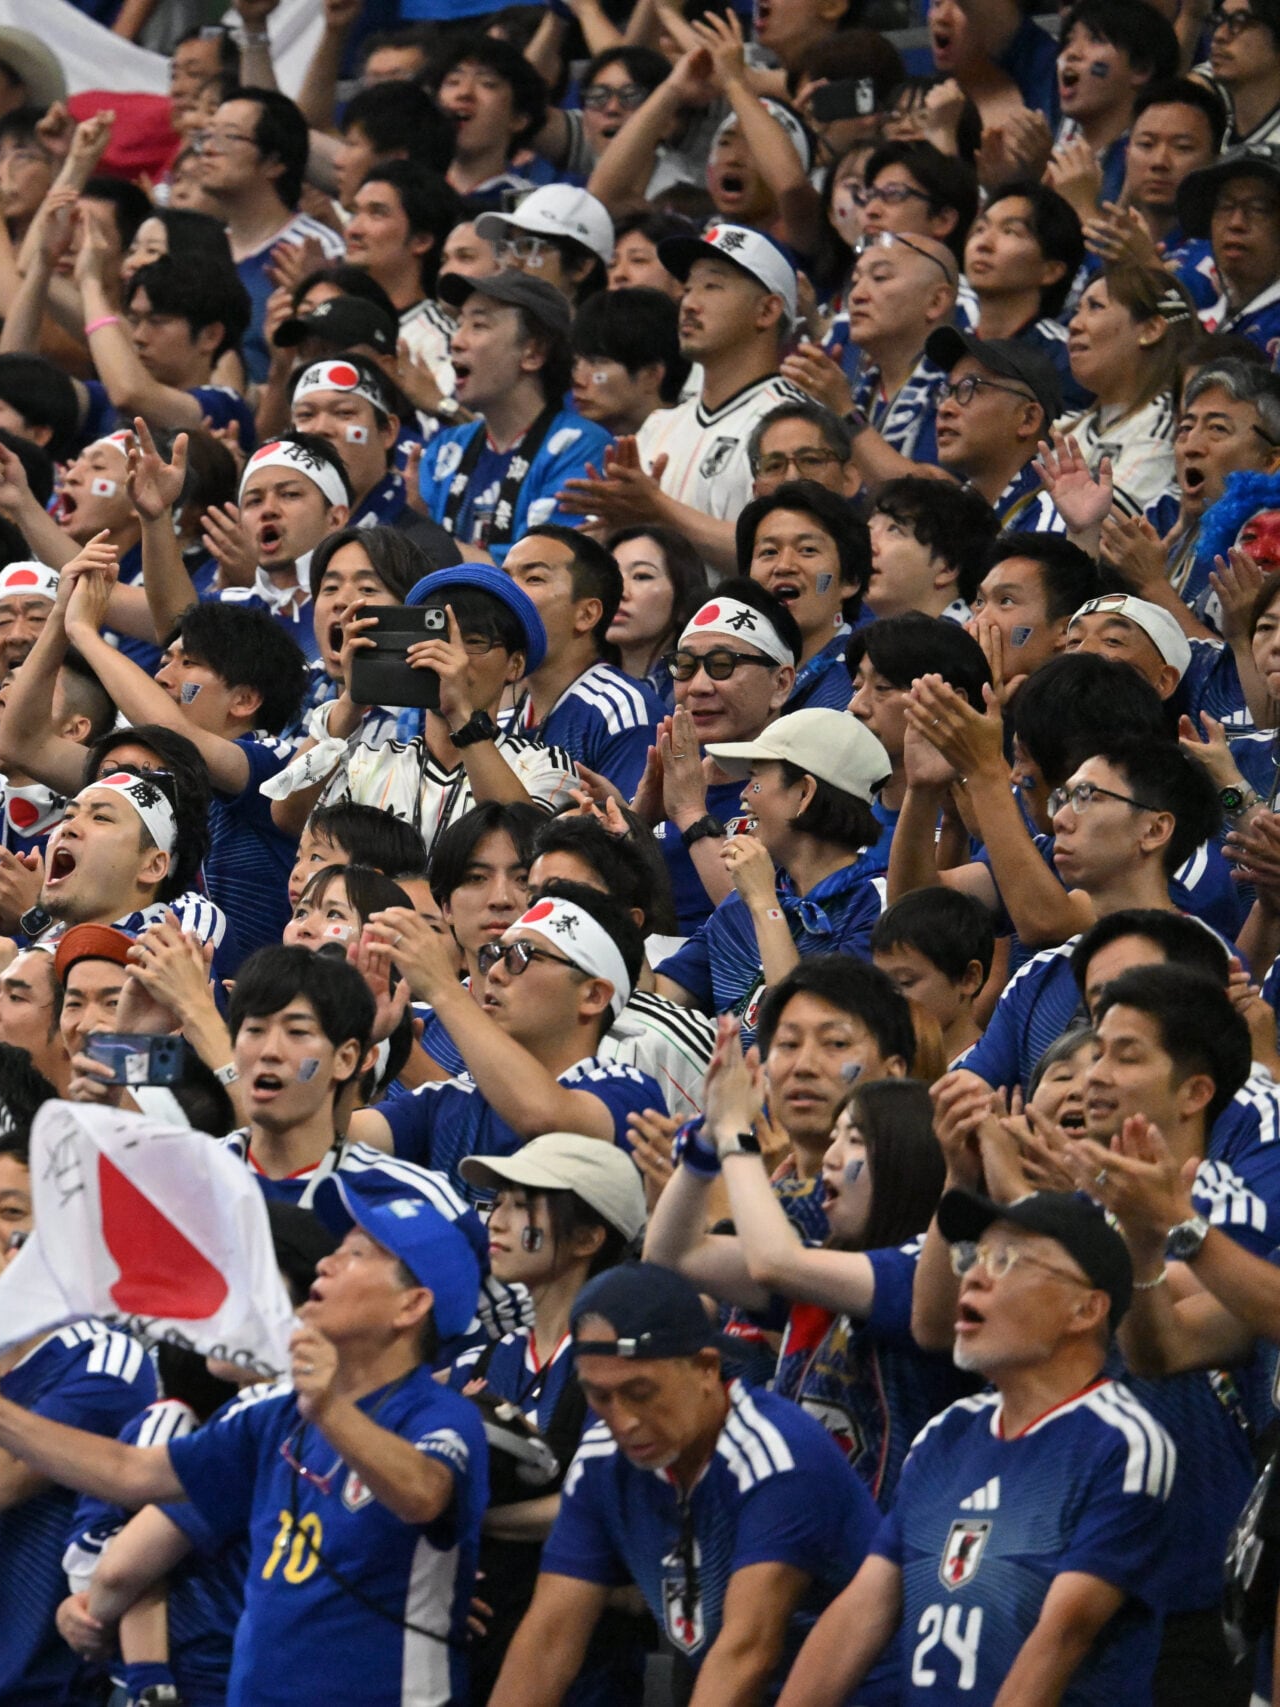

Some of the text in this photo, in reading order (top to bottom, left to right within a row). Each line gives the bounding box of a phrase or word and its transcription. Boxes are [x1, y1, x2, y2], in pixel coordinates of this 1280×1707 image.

[725, 609, 758, 631] 本
[123, 780, 162, 810] 勝
[261, 1509, 323, 1584] 10
[911, 1603, 984, 1692] 24
